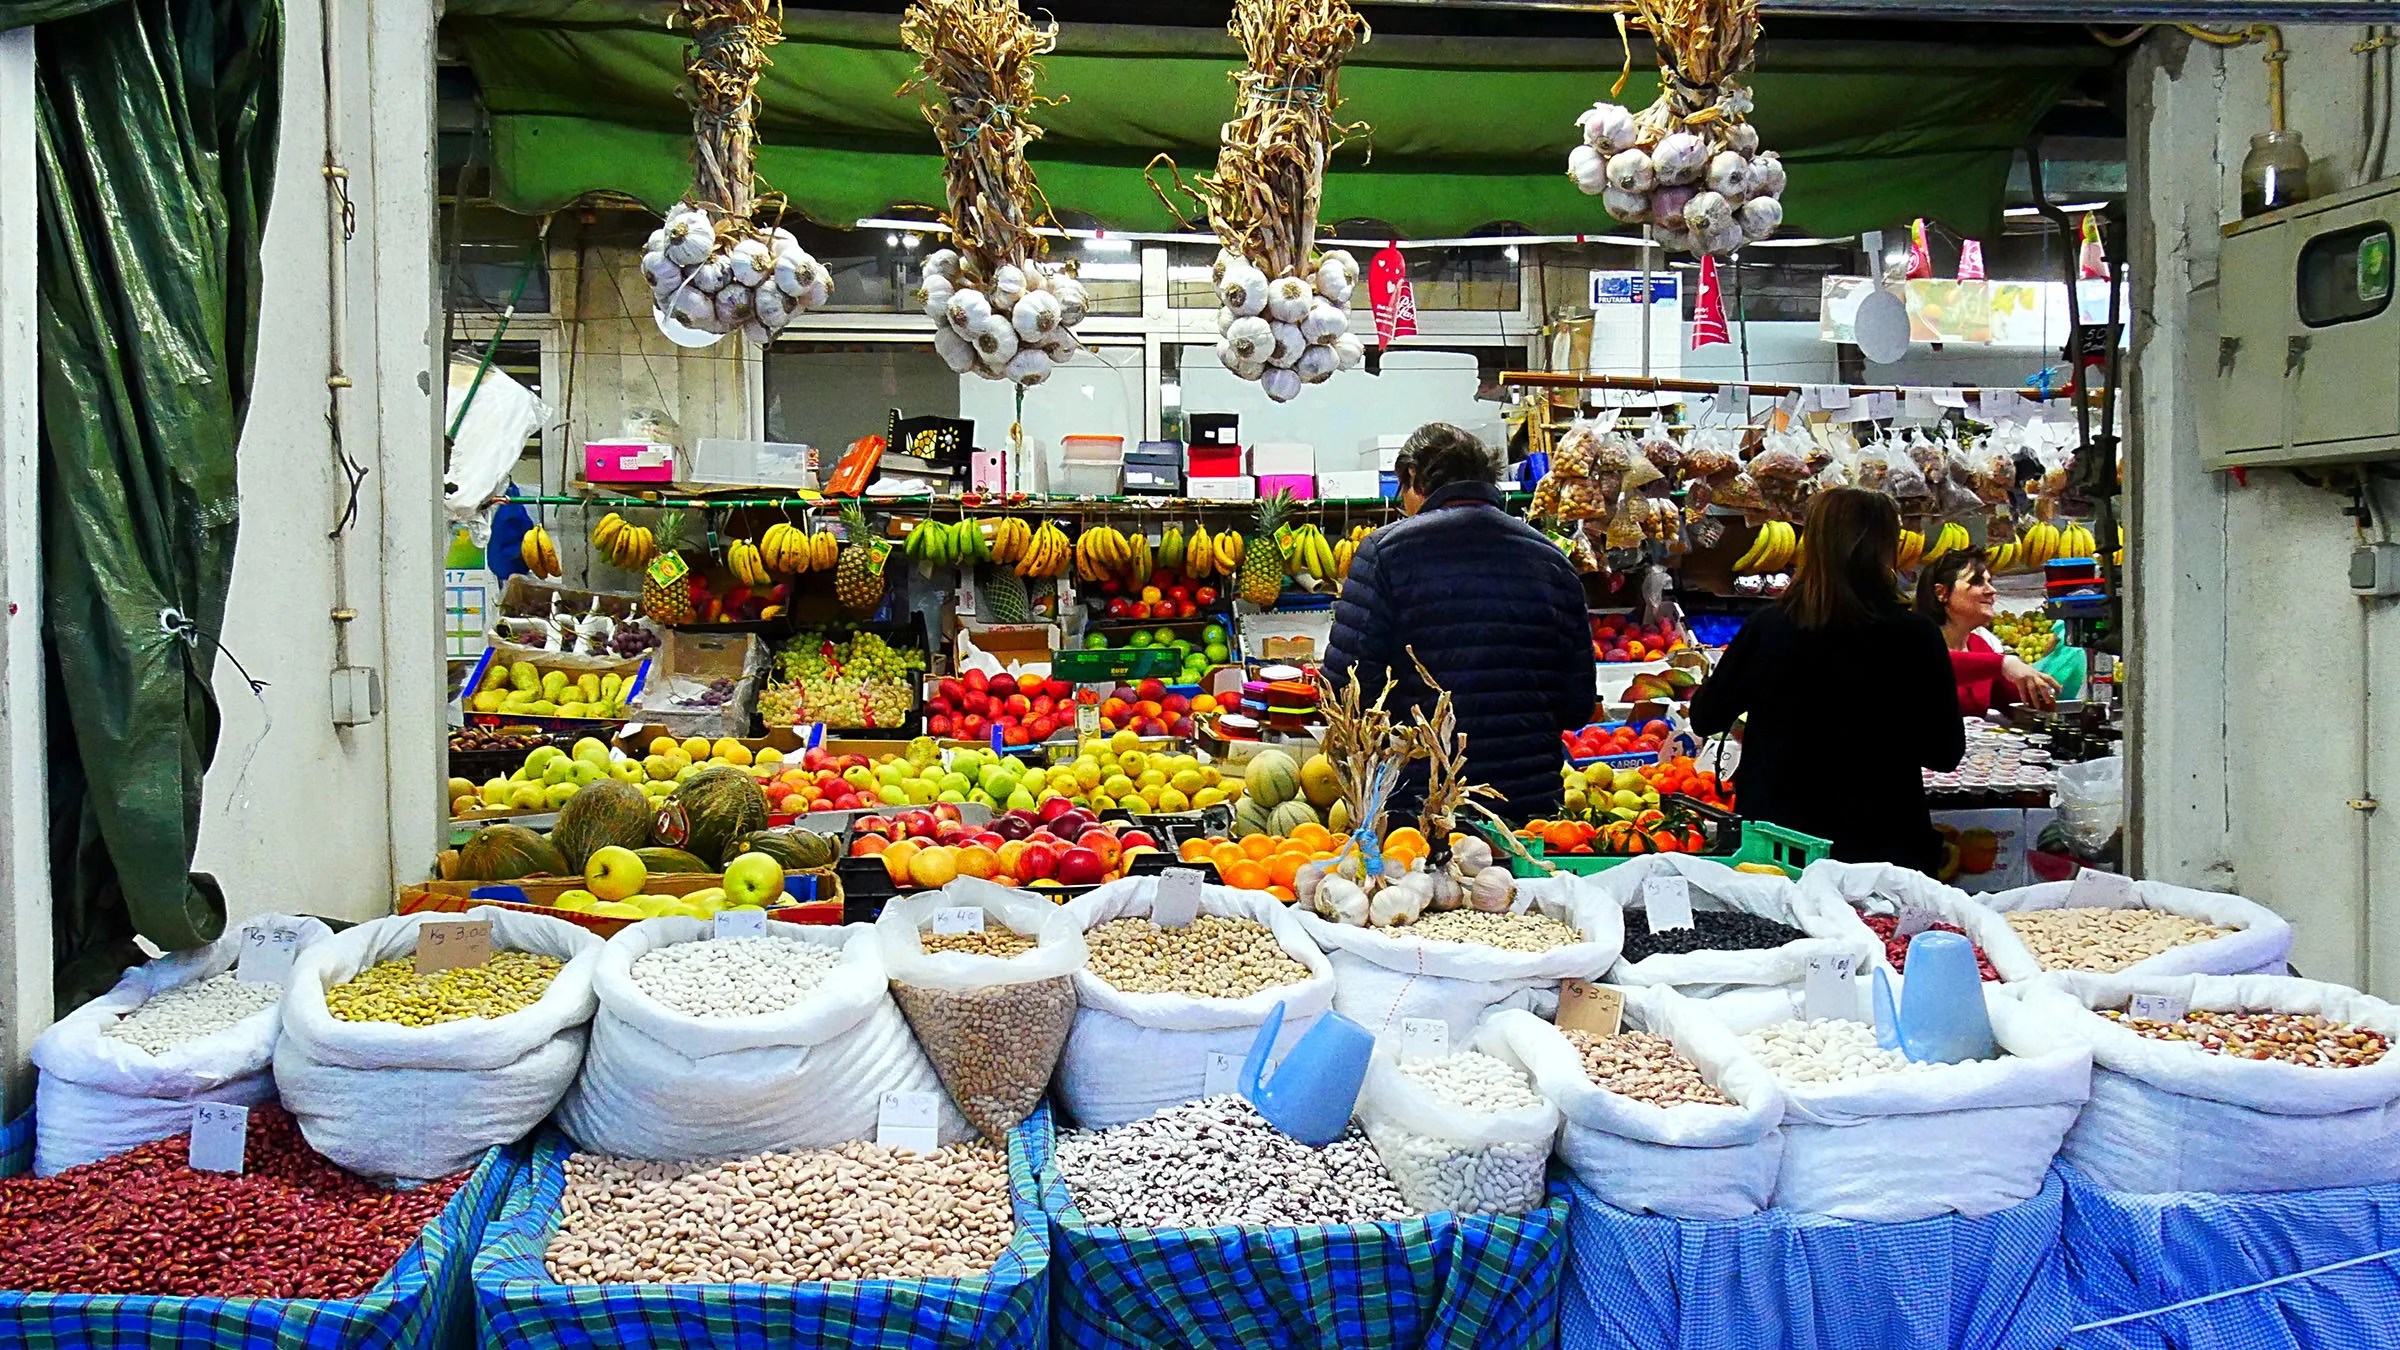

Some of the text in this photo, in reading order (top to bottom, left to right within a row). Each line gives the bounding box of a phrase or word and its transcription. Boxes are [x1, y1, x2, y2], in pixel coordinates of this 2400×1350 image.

[250, 929, 266, 947] Kg
[430, 928, 445, 945] Kg
[1568, 981, 1583, 998] Kg
[1405, 1021, 1417, 1038] Kg
[1217, 1055, 1230, 1072] Kg
[885, 1094, 899, 1110] Kg
[199, 1107, 213, 1125] Kg
